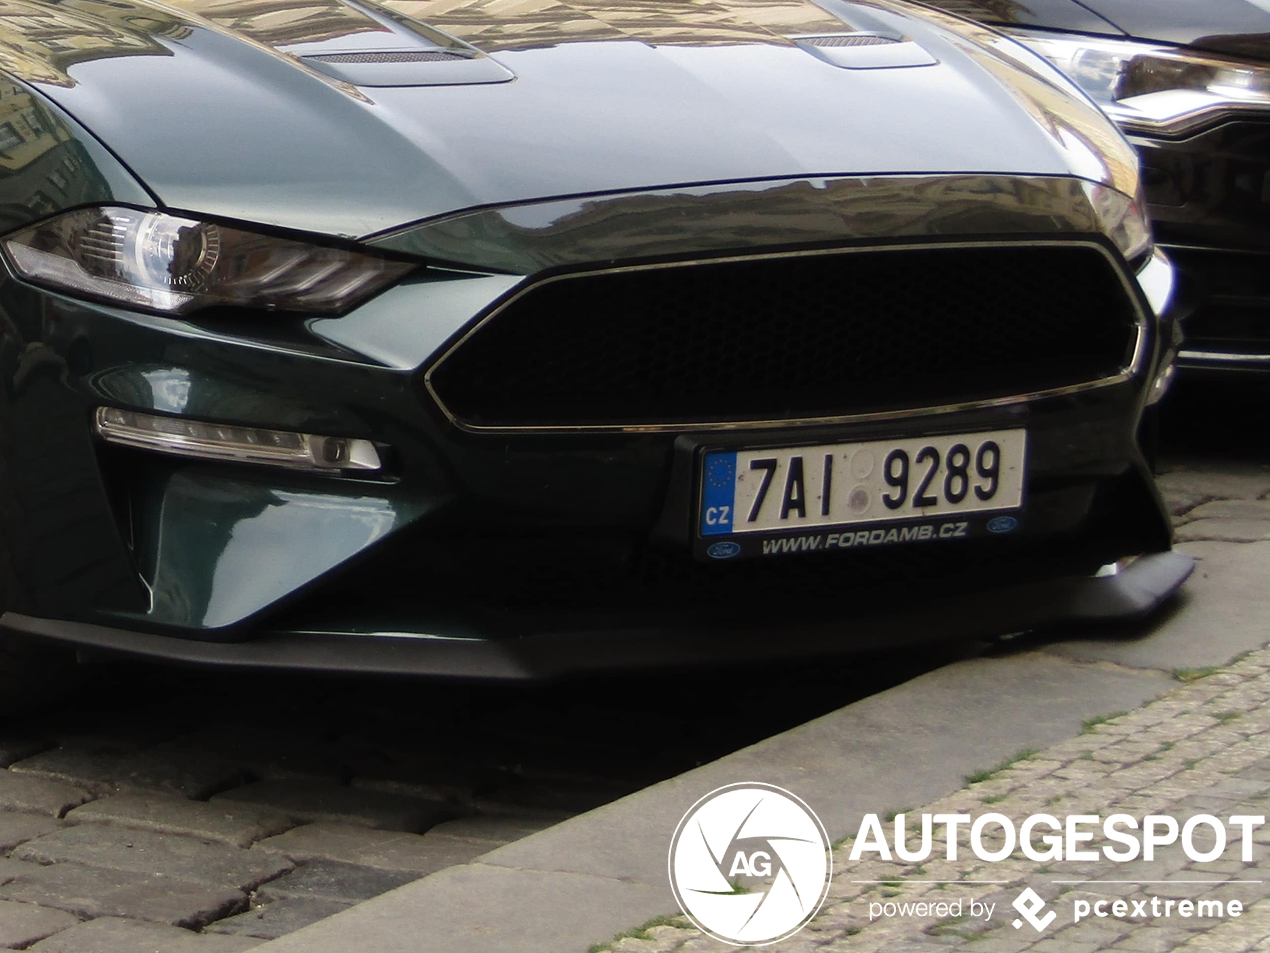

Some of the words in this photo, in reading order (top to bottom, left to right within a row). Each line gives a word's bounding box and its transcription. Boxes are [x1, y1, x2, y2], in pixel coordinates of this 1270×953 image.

[746, 453, 834, 523] 7AI
[881, 440, 1001, 511] 9289
[705, 505, 730, 526] CZ
[762, 521, 969, 555] WWW.FORDAMB.CZ
